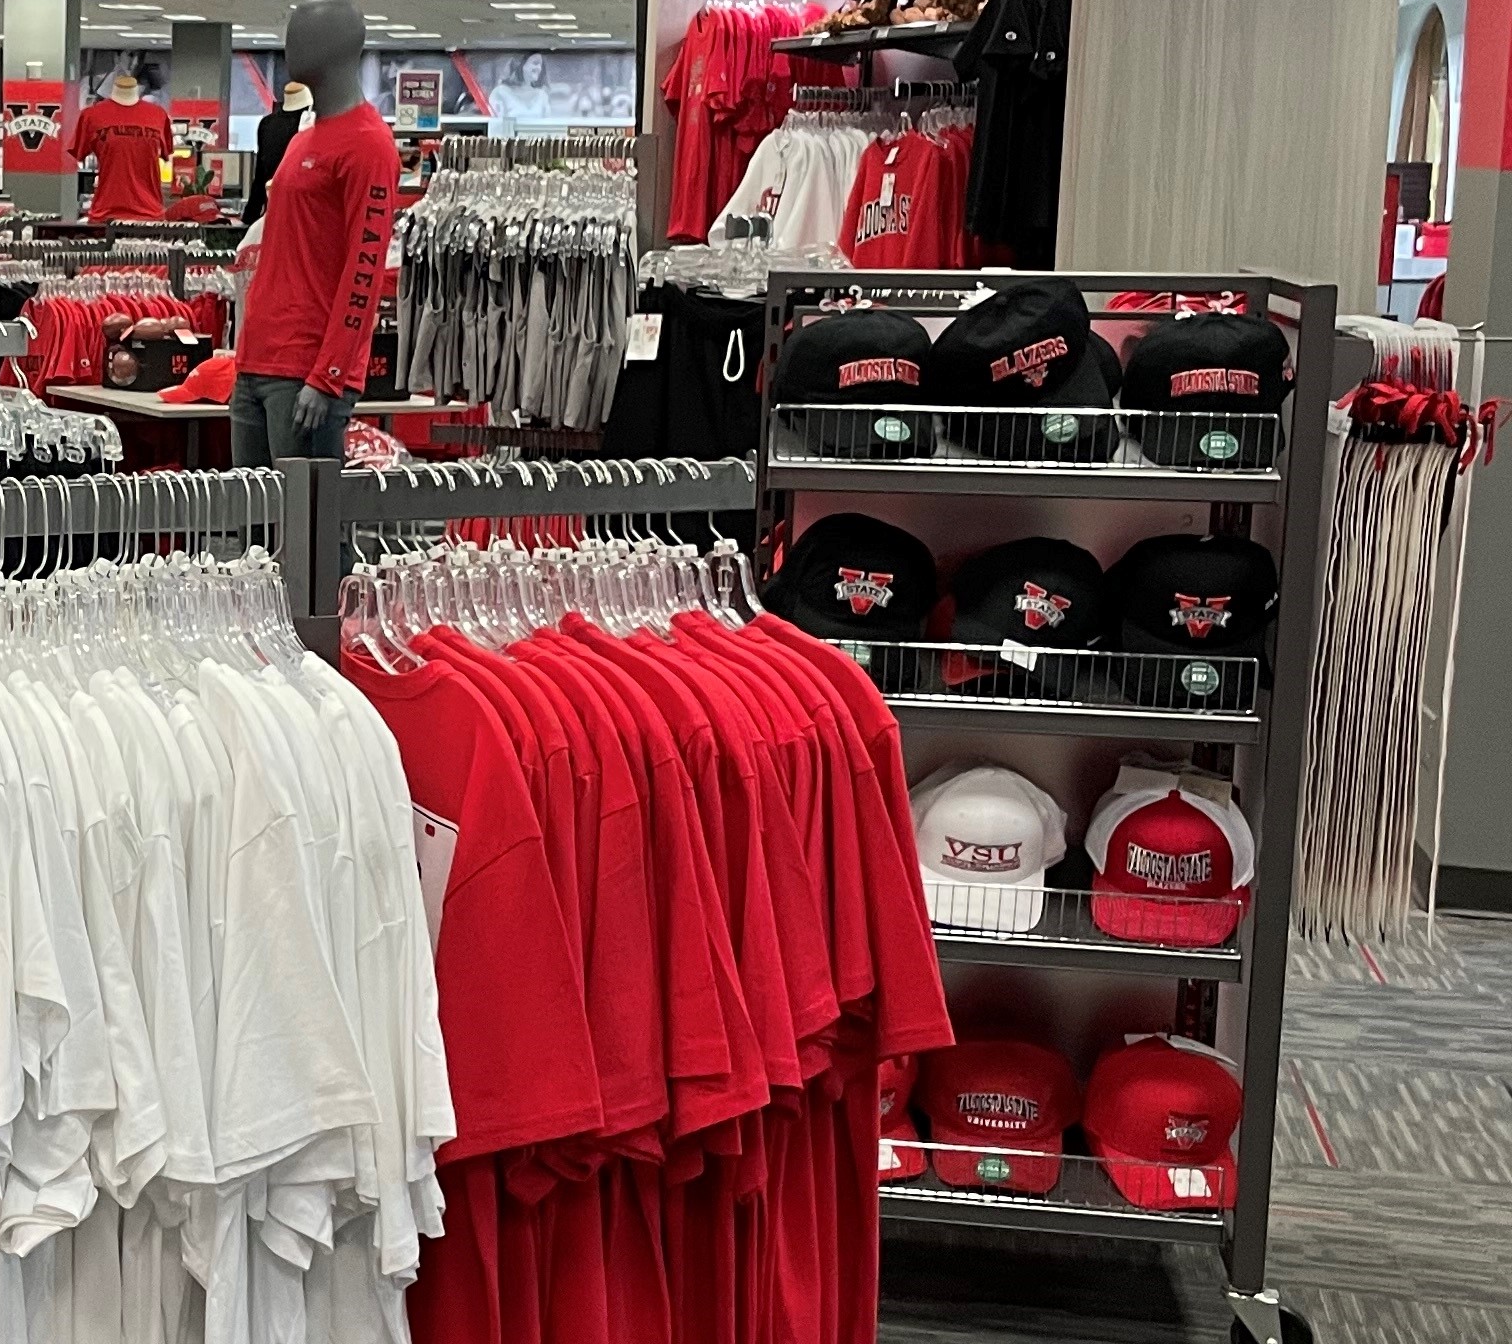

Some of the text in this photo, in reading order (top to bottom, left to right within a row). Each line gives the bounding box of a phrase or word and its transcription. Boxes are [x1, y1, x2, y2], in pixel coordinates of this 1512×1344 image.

[14, 118, 50, 131] STATE
[344, 184, 388, 331] BLAZERS
[990, 336, 1068, 382] BLAZERS
[846, 584, 882, 599] STATE
[944, 835, 1023, 864] VSU
[1126, 841, 1213, 885] VALDOSTA STATE
[966, 1115, 1029, 1130] UNIVERSITY
